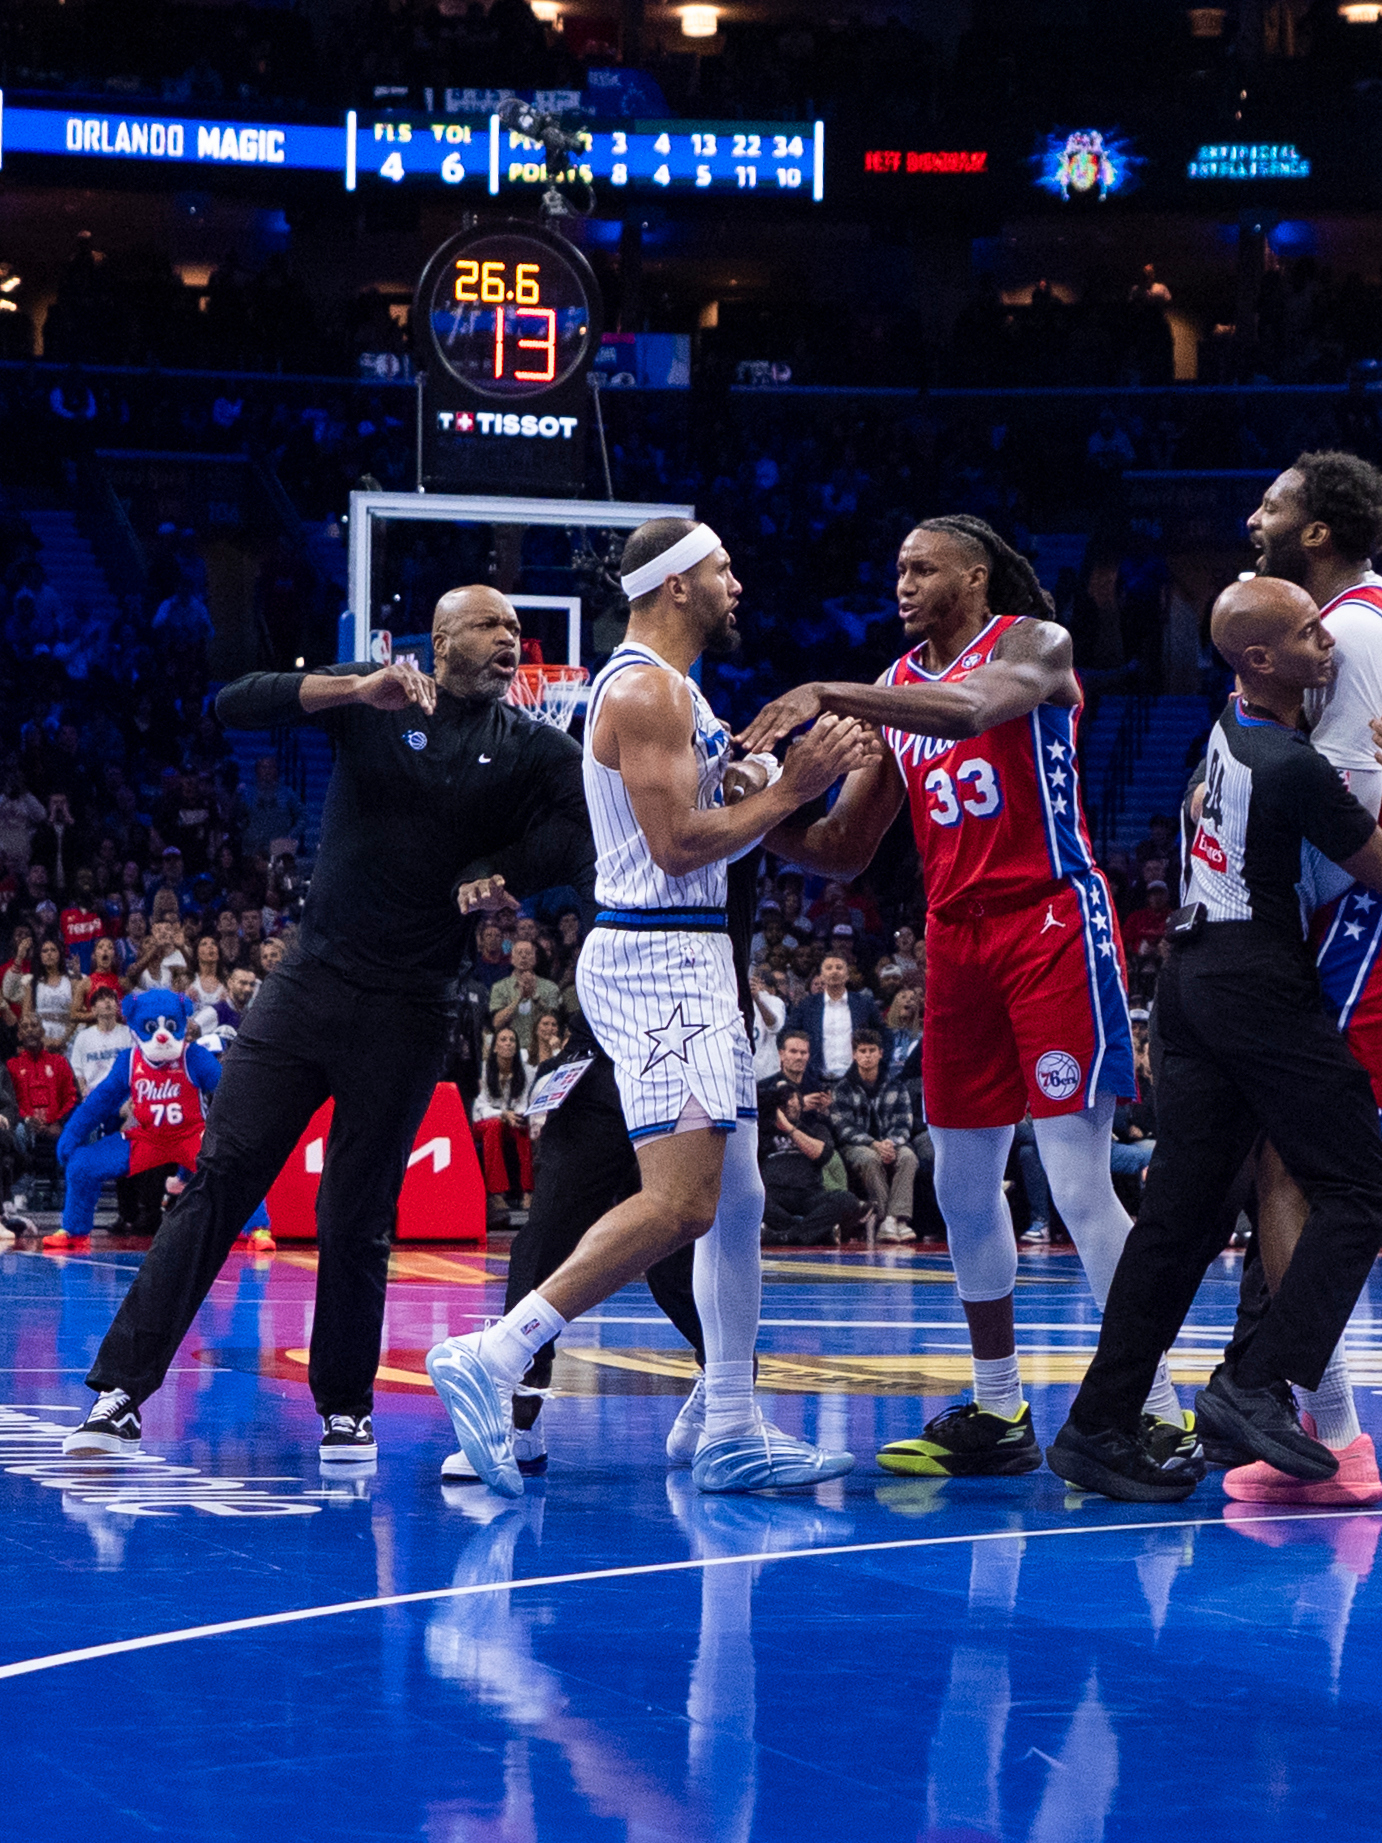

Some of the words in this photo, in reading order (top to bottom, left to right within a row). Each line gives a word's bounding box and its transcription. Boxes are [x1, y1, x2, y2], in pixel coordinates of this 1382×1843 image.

[66, 118, 184, 157] ORLANDO
[198, 126, 285, 163] MAGIC
[612, 132, 627, 155] 3
[654, 133, 671, 155] 4
[691, 134, 717, 156] 13
[731, 135, 761, 157] 22
[773, 136, 803, 158] 34
[380, 151, 404, 182] 4
[441, 151, 465, 183] 6
[611, 163, 627, 185] 8
[654, 164, 671, 186] 4
[696, 165, 712, 187] 5
[735, 166, 757, 188] 11
[777, 168, 802, 188] 10
[455, 260, 540, 305] 26.6
[493, 306, 556, 382] 13
[476, 412, 578, 438] TISSOT
[925, 757, 1003, 829] 33
[135, 1078, 181, 1104] Phila
[1039, 1069, 1079, 1088] 76ers
[150, 1103, 183, 1127] 76
